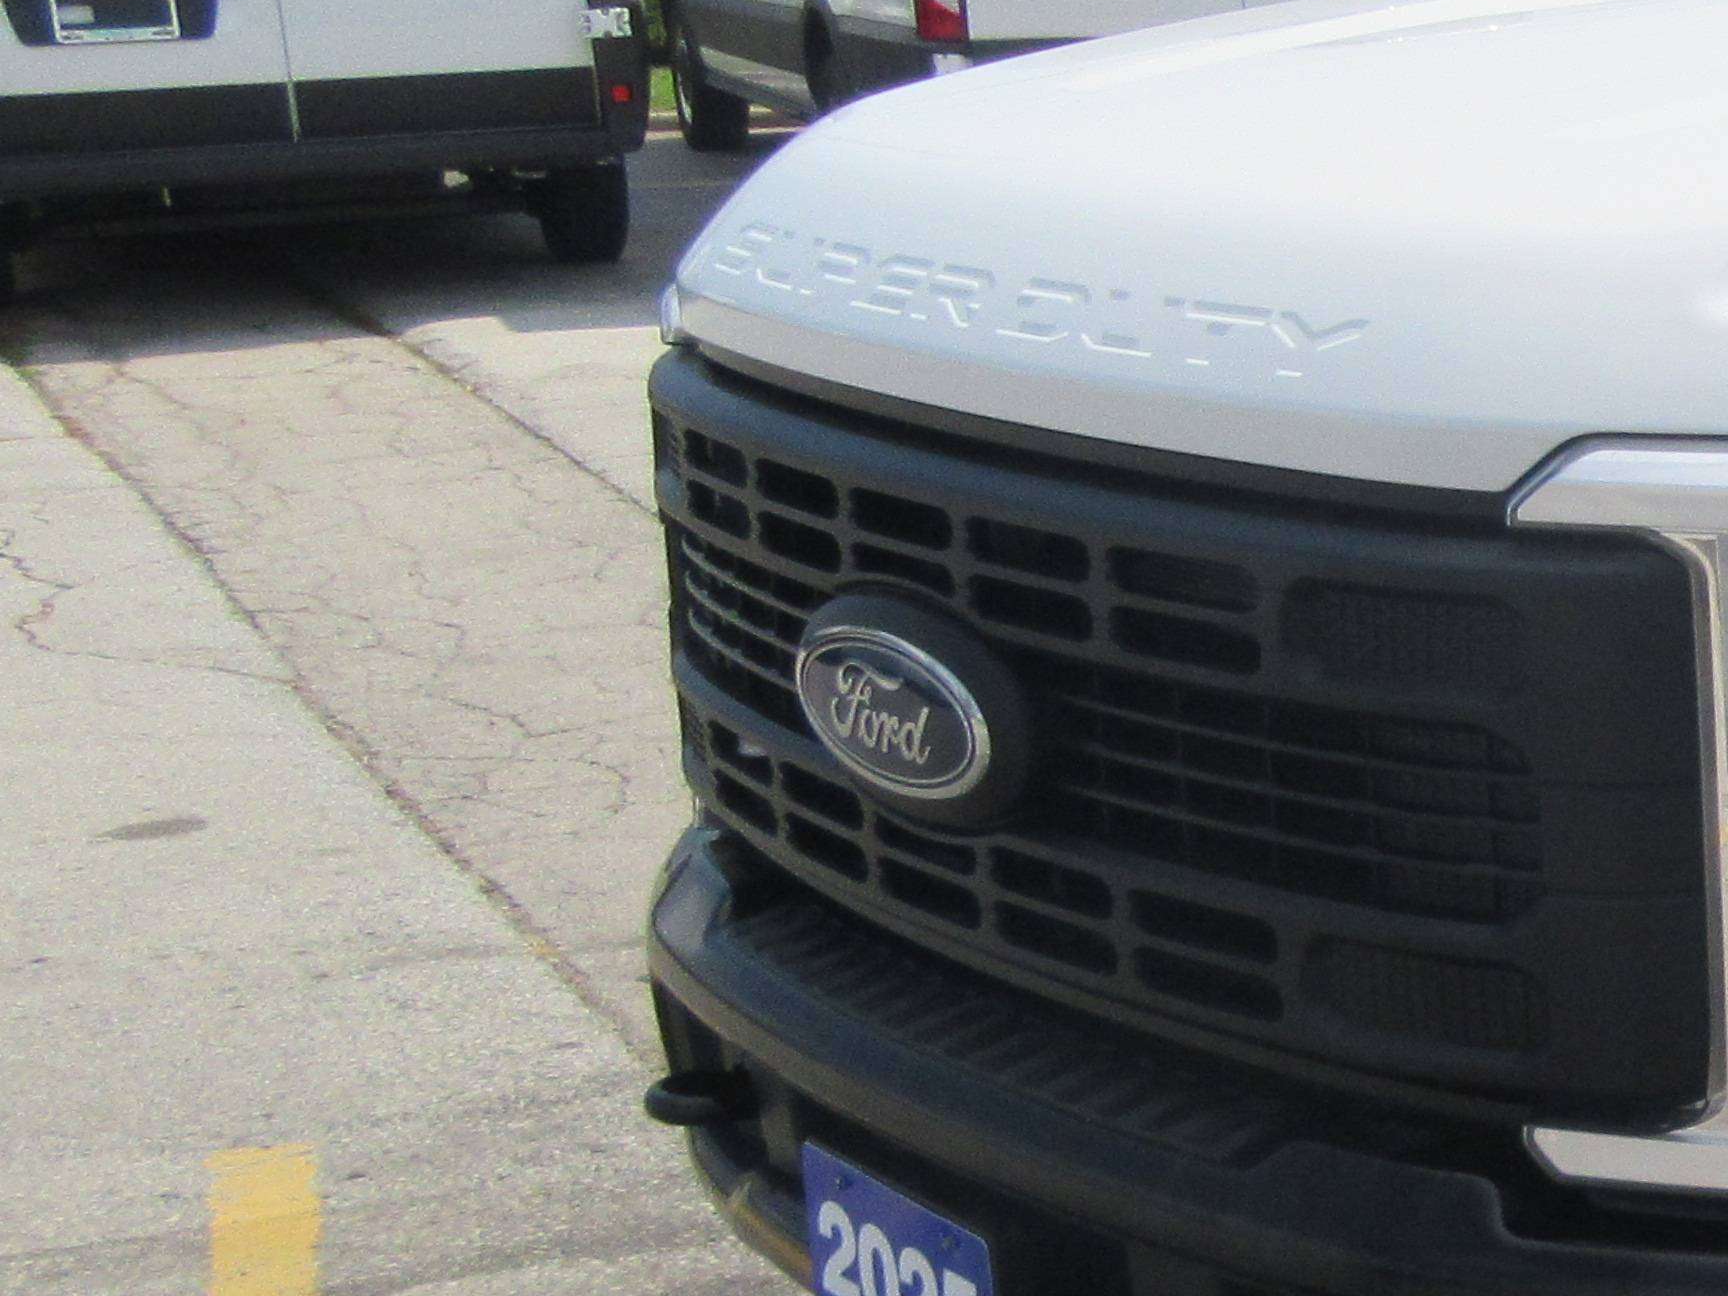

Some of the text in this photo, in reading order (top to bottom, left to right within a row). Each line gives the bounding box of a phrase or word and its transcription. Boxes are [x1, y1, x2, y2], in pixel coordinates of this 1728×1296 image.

[714, 222, 1370, 379] SUPER DUTY
[831, 661, 931, 765] Ford
